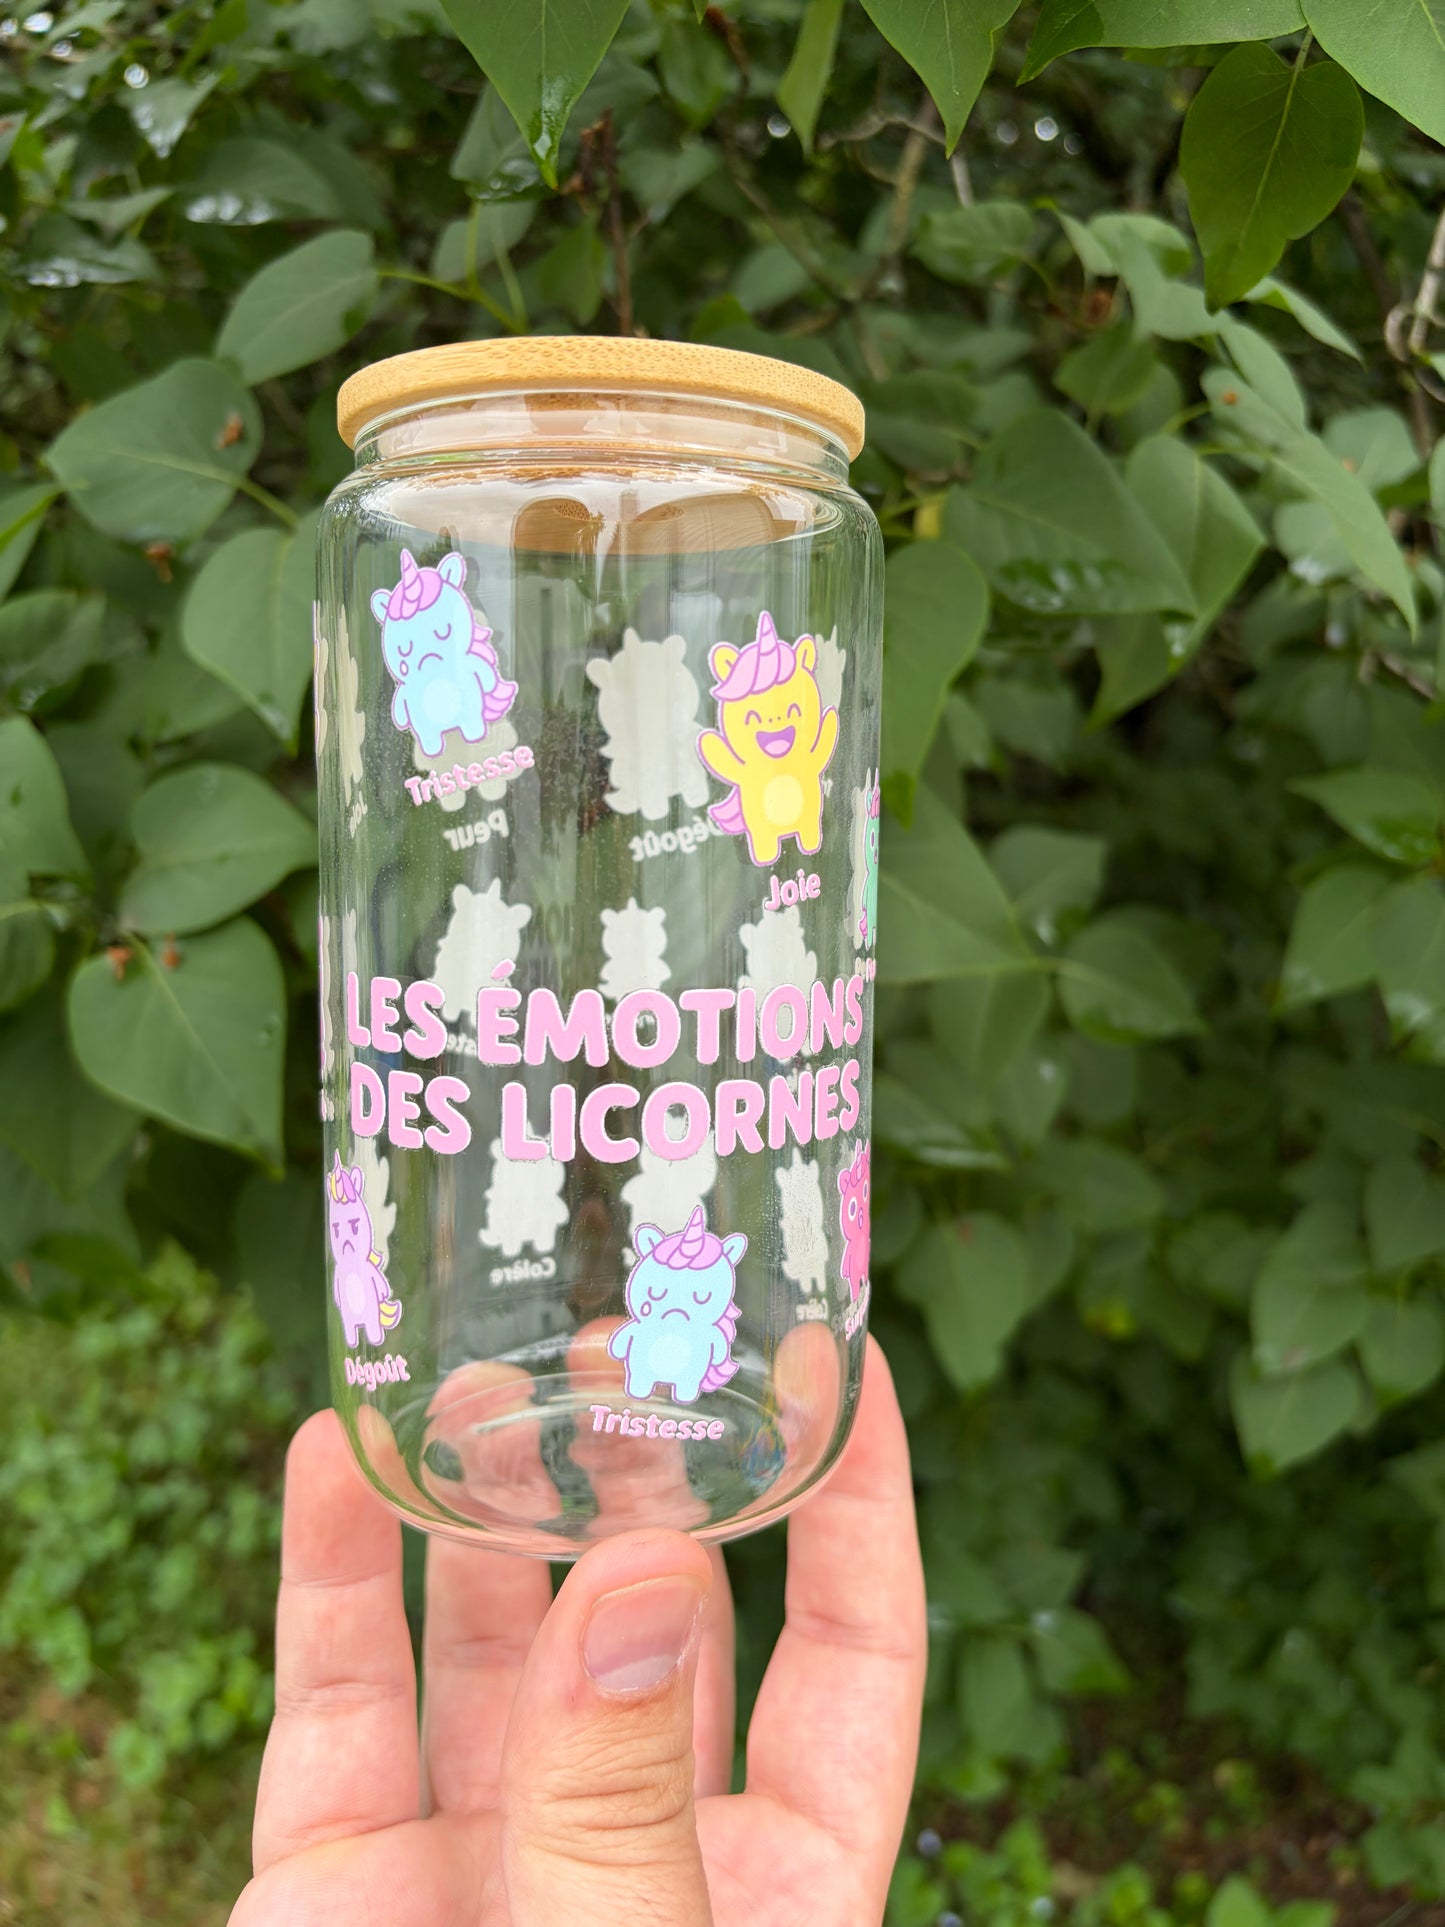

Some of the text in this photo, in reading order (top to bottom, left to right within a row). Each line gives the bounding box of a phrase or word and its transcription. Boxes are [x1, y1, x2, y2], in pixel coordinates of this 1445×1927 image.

[404, 746, 535, 806] Tristesse
[764, 868, 821, 911] Joie
[347, 959, 864, 1068] LES ÉMOTIONS
[350, 1060, 861, 1163] DES LICORNES
[345, 1354, 411, 1391] Dégoût
[589, 1405, 725, 1440] Tristesse
